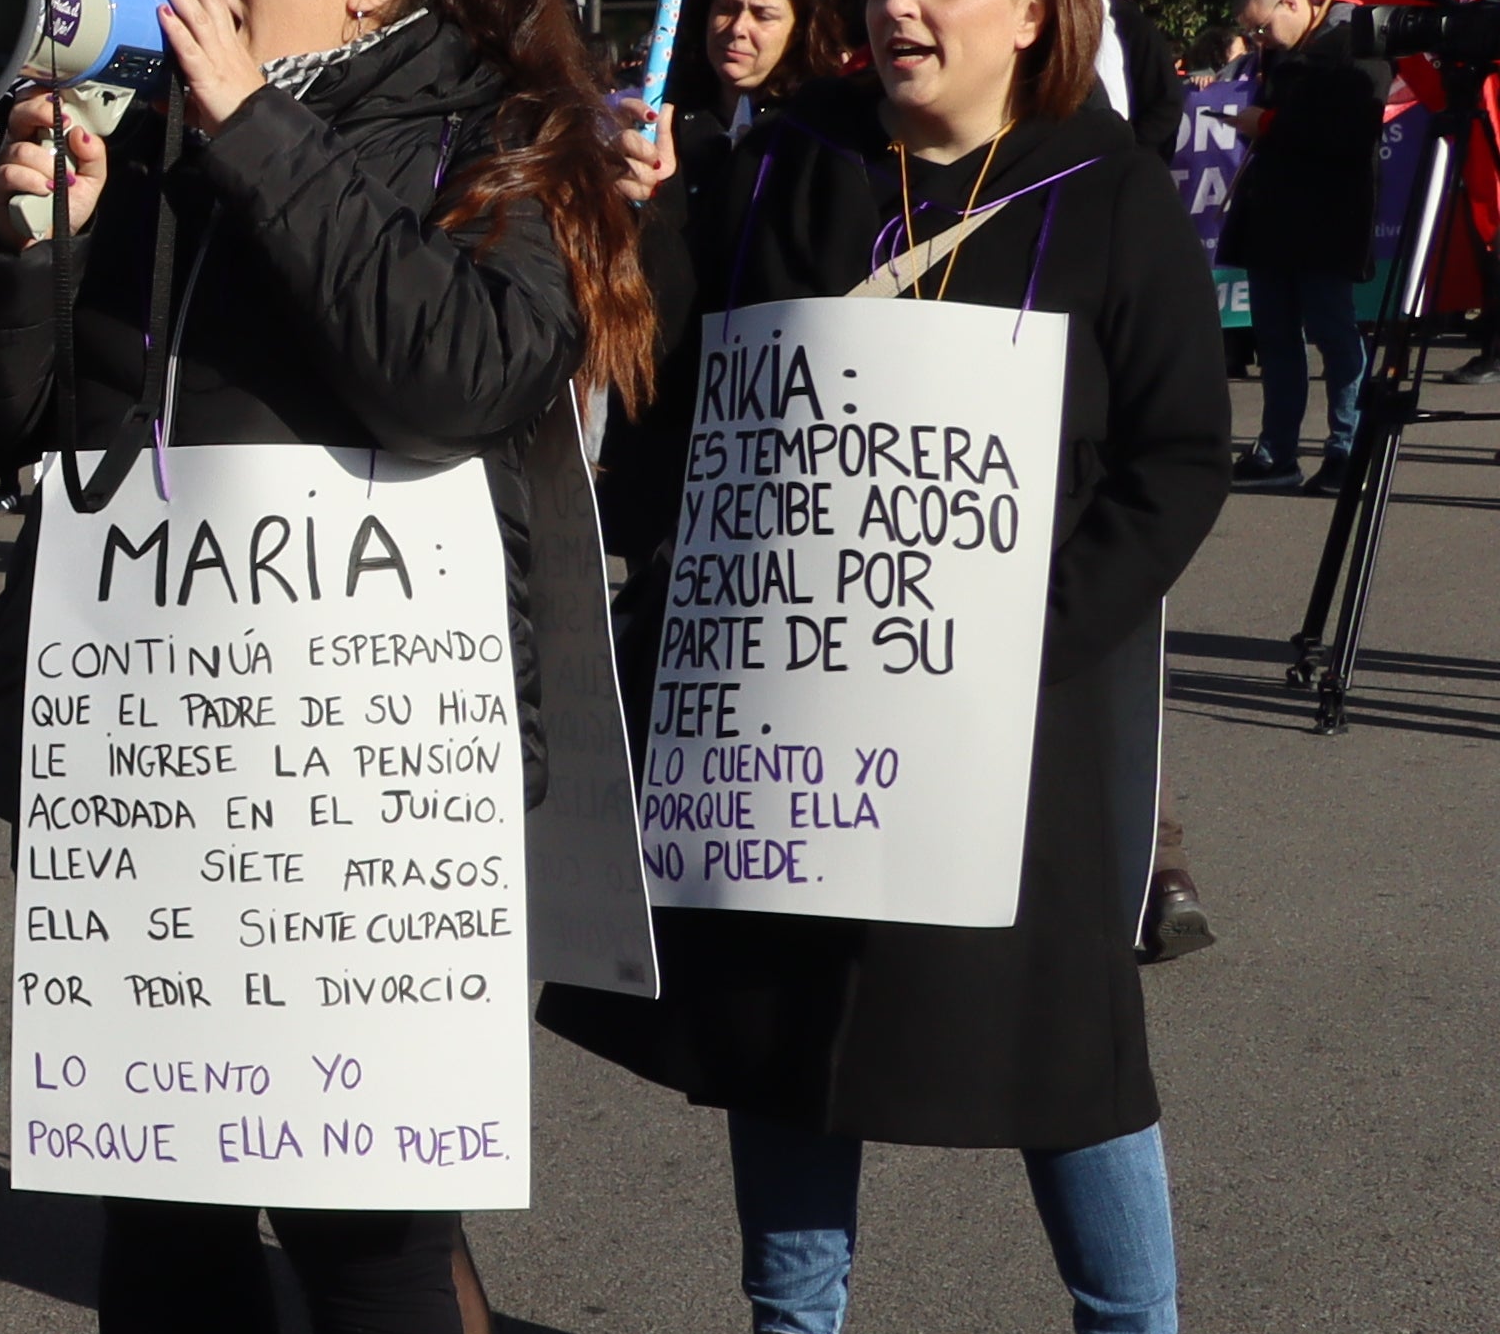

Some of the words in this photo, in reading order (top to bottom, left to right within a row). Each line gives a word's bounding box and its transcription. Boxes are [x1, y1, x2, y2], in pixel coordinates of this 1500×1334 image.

[701, 328, 858, 424] RIKIA:
[686, 430, 727, 482] ES
[736, 422, 1019, 490] TEMPORERA
[685, 490, 703, 546] Y
[710, 481, 835, 543] RECIBE
[859, 488, 1019, 555] ACOSO
[672, 547, 813, 608] SEXUAL
[837, 547, 934, 611] POR
[38, 626, 273, 681] CONTINÚA
[308, 630, 503, 667] ESPERANDO
[660, 614, 764, 673] PARTE
[785, 614, 848, 674] DE
[873, 617, 954, 677] SU
[30, 694, 92, 730] QUE
[118, 694, 159, 730] EL
[181, 692, 275, 731] PADRE
[300, 694, 343, 729] DE
[363, 693, 414, 728] SU
[437, 690, 508, 729] HIJA
[30, 740, 67, 781] LE
[106, 732, 237, 777] INGRESE
[273, 742, 330, 780] LA
[355, 735, 501, 777] PENSIÓN
[647, 745, 684, 788] LO
[702, 743, 824, 786] CUENTO
[855, 746, 899, 789] YO
[27, 793, 197, 832] ACORDADA
[227, 794, 273, 830] EN
[309, 794, 353, 827] EL
[380, 788, 504, 827] JUICIO.
[643, 791, 755, 831] PORQUE
[790, 791, 880, 831] ELLA
[29, 845, 138, 884] LLEVA
[199, 844, 305, 885] SIETE
[343, 852, 510, 893] ATRASOS.
[703, 839, 824, 885] PUEDE.
[29, 906, 110, 944] ELLA
[147, 906, 195, 941] SE
[239, 906, 357, 948] SIENTE
[365, 906, 512, 943] CULPABLE
[19, 972, 94, 1010] POR
[124, 971, 212, 1010] PEDIR
[244, 971, 286, 1007] EL
[319, 971, 492, 1007] DIVORCIO.
[34, 1051, 87, 1092] LO
[124, 1059, 271, 1097] CUENTO
[311, 1053, 362, 1092] YO
[29, 1119, 178, 1165] PORQUE
[218, 1114, 304, 1163] ELLA
[323, 1122, 374, 1158] NO
[398, 1119, 510, 1169] PUEDE.
